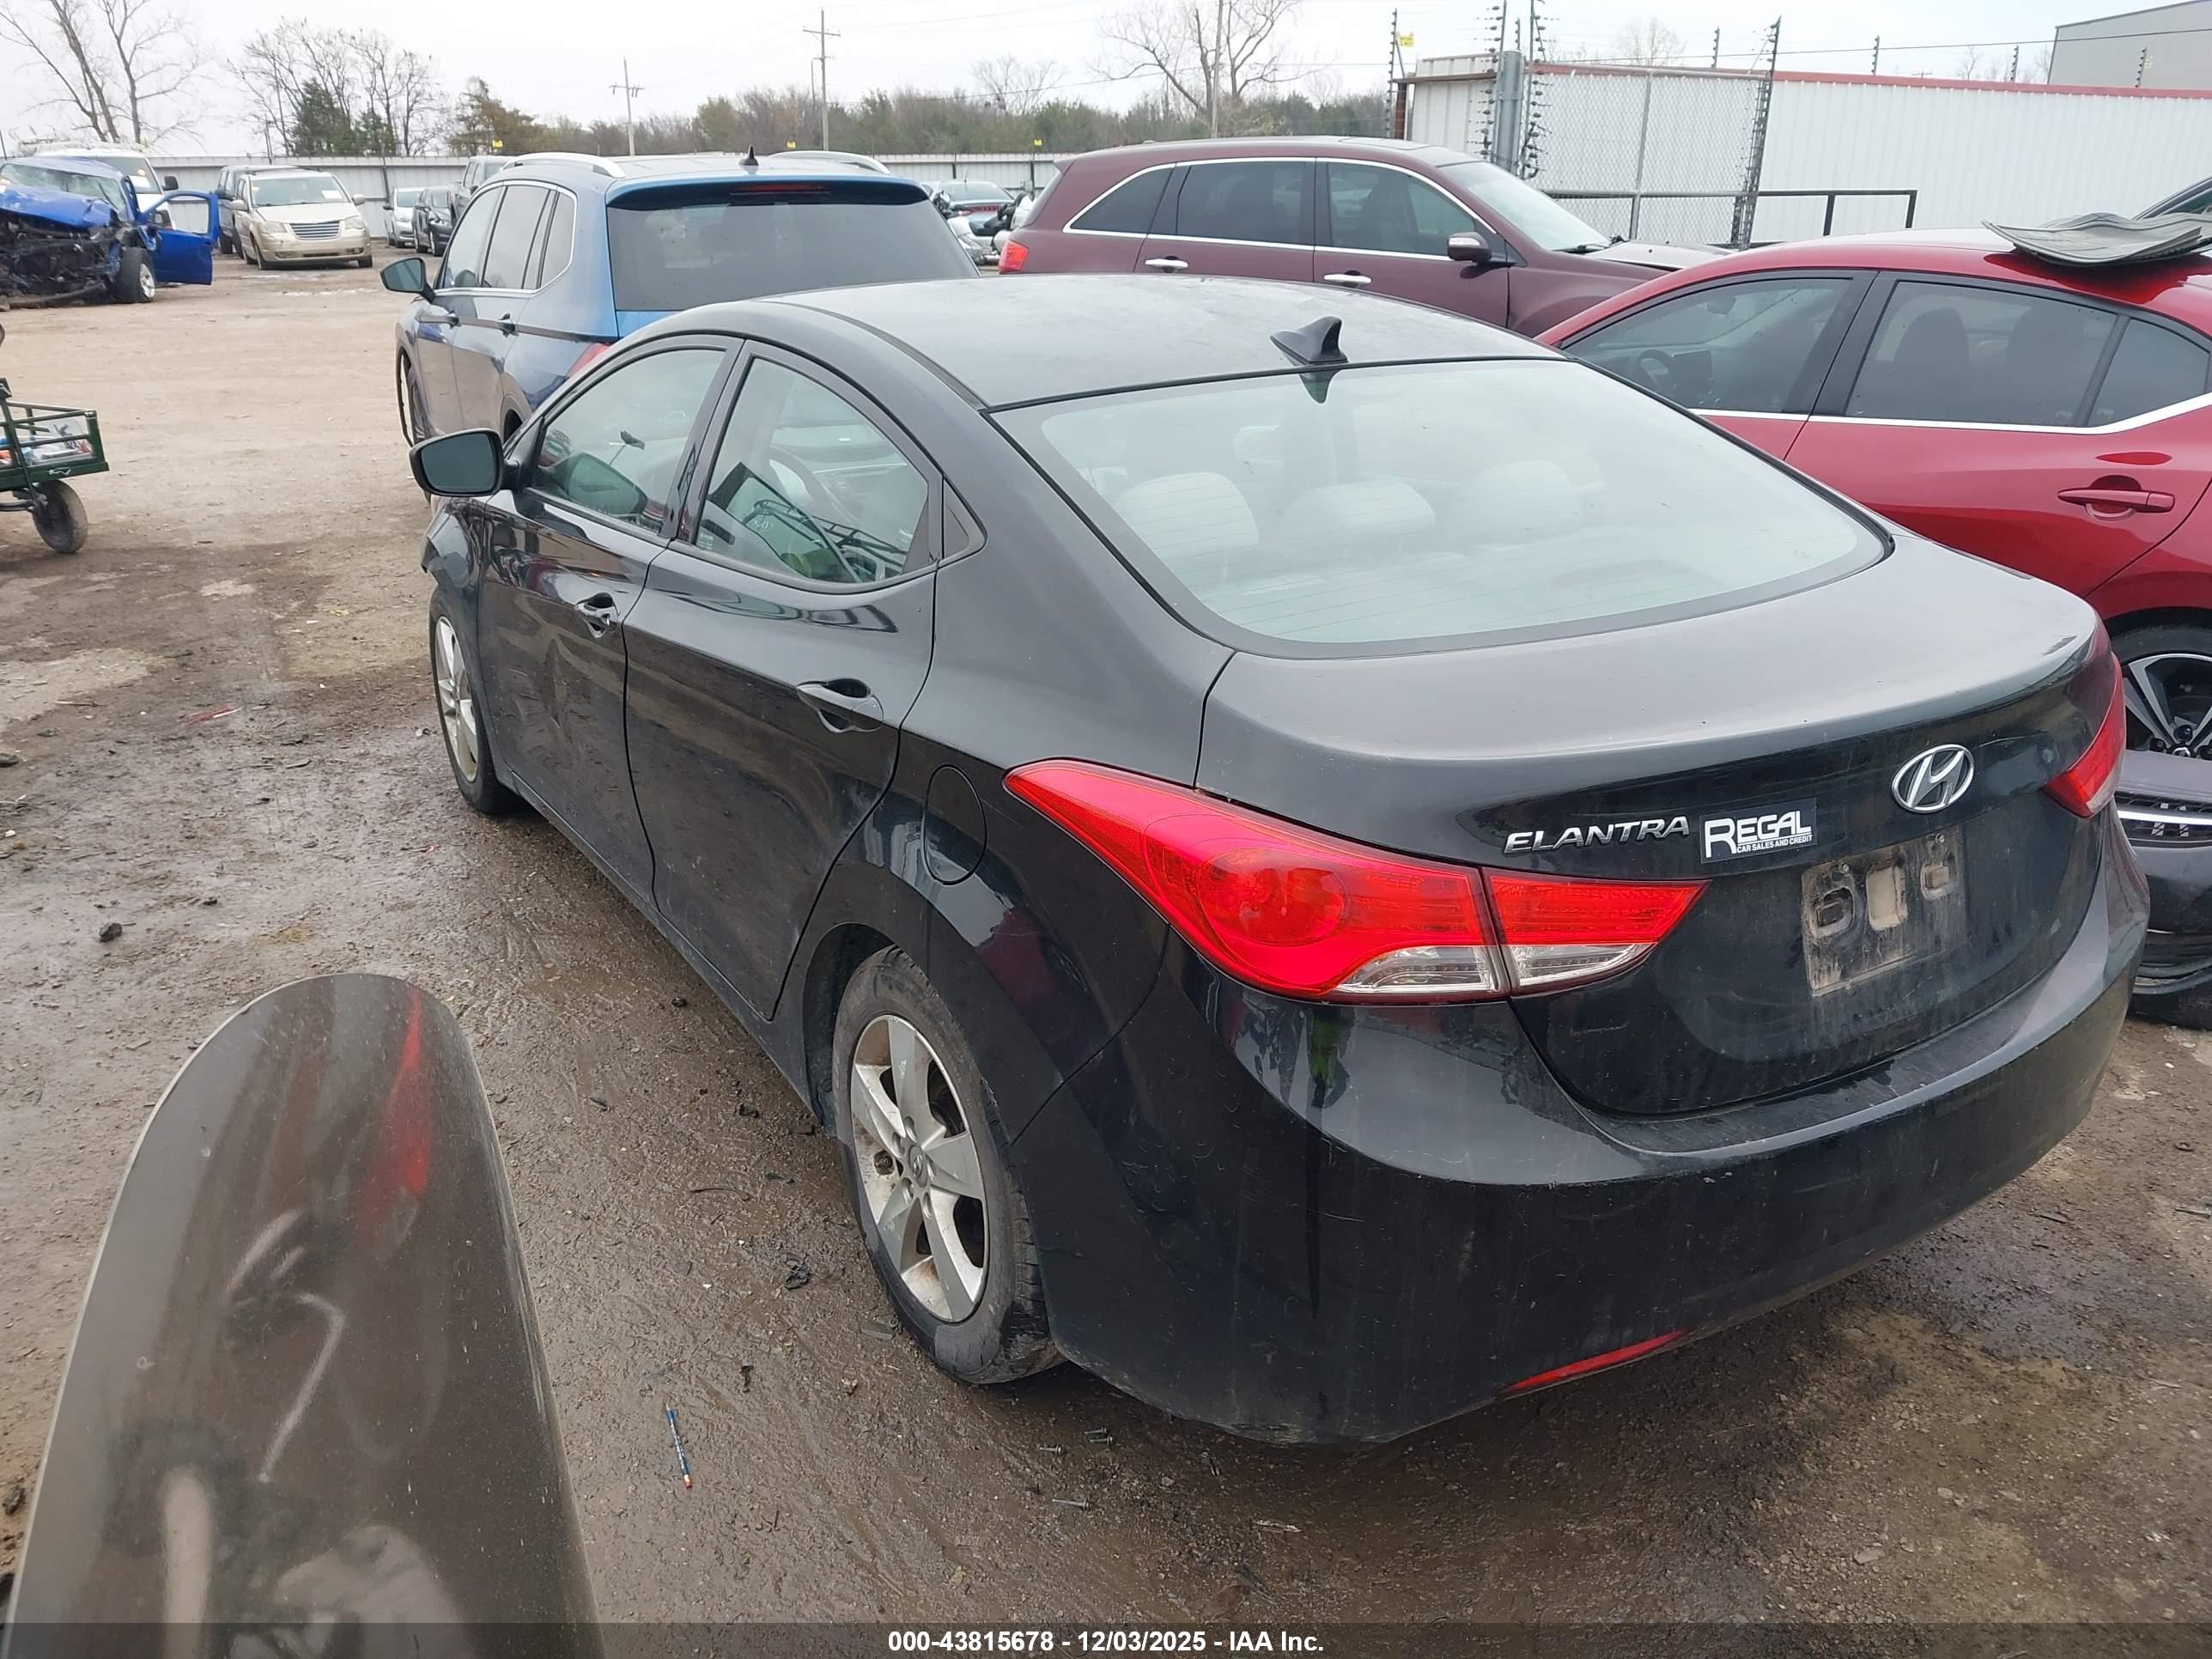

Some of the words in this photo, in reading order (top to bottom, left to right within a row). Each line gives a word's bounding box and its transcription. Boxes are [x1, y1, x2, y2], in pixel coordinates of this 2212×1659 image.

[1504, 815, 1690, 854] ELANTRA
[1705, 810, 1812, 859] REGAL
[1737, 845, 1752, 854] CAR
[1753, 842, 1774, 851] SALES
[1775, 838, 1789, 847] AND
[1789, 835, 1813, 845] CREDIT
